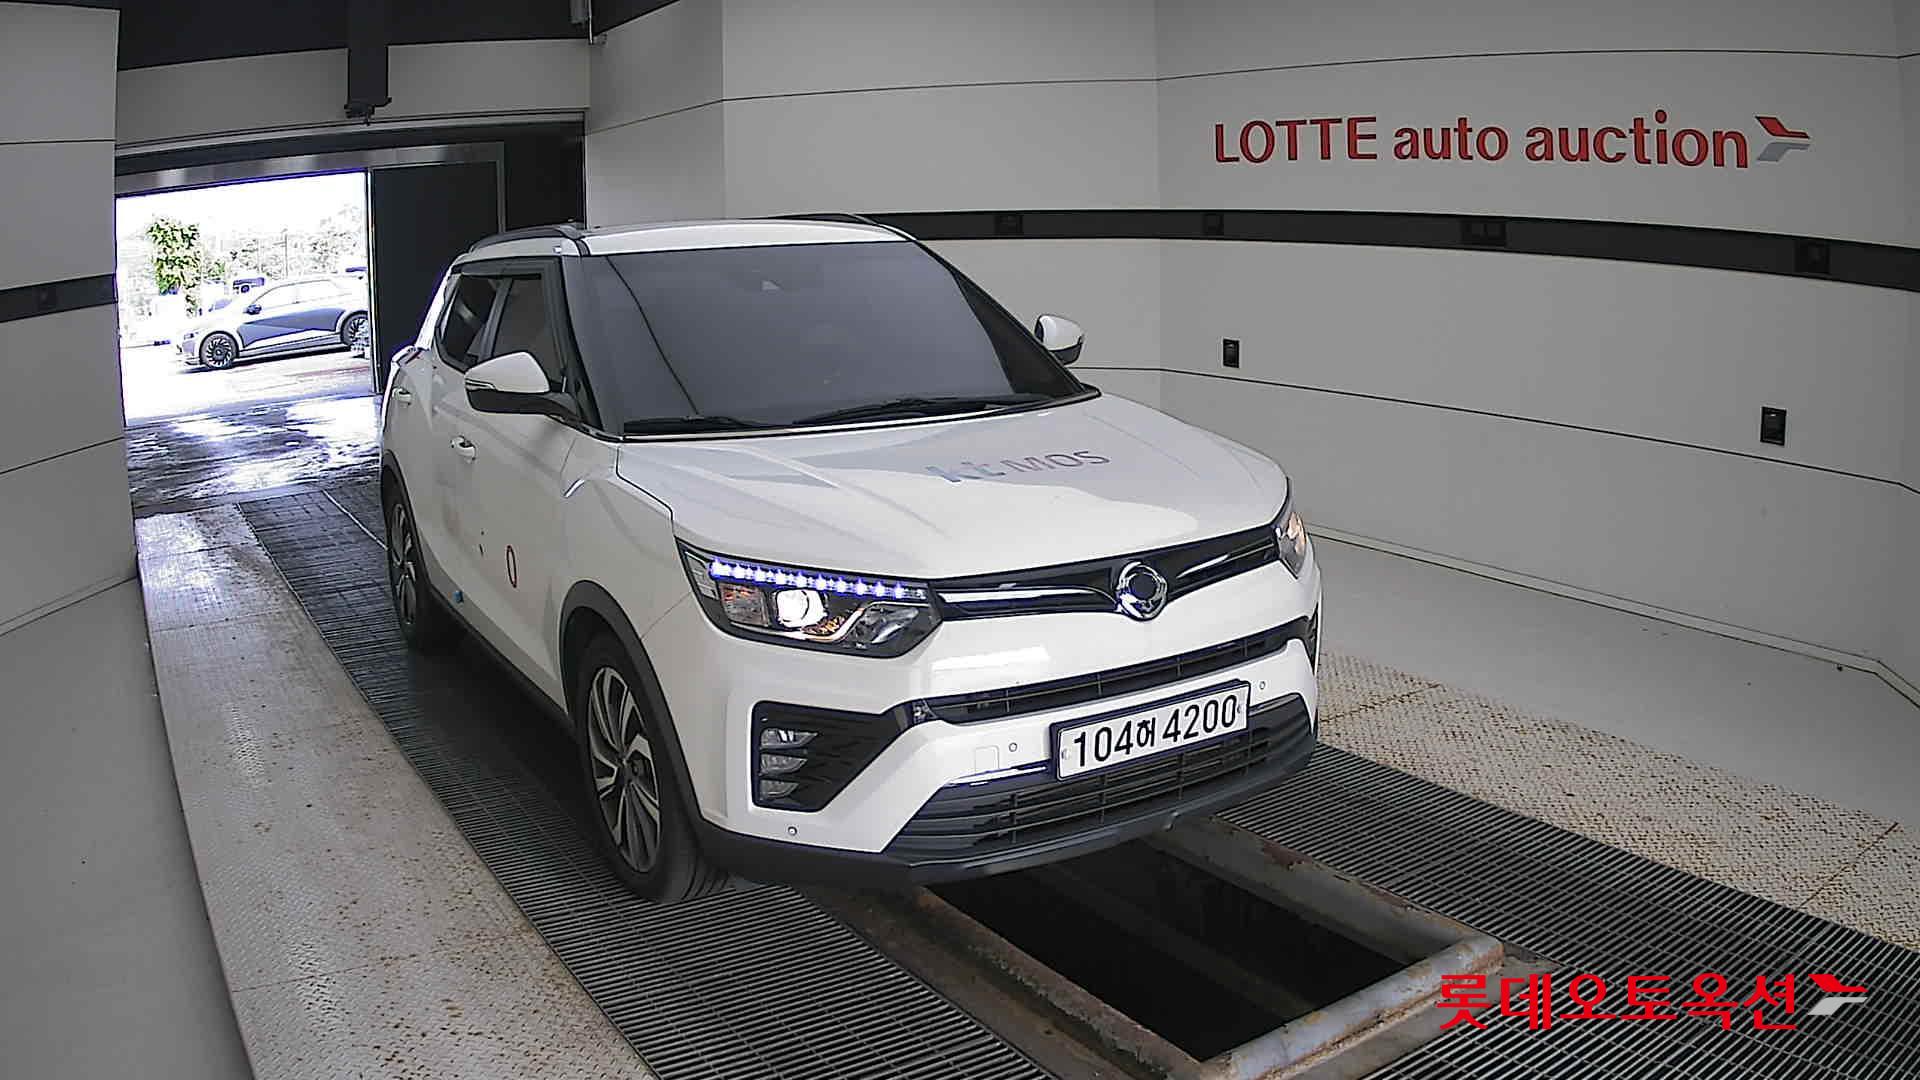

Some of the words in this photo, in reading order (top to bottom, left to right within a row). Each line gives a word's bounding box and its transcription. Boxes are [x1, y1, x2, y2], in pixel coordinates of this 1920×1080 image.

[1214, 117, 1377, 163] LOTTE
[1393, 117, 1510, 161] auto
[1525, 109, 1749, 168] auction
[1162, 694, 1238, 743] 4200
